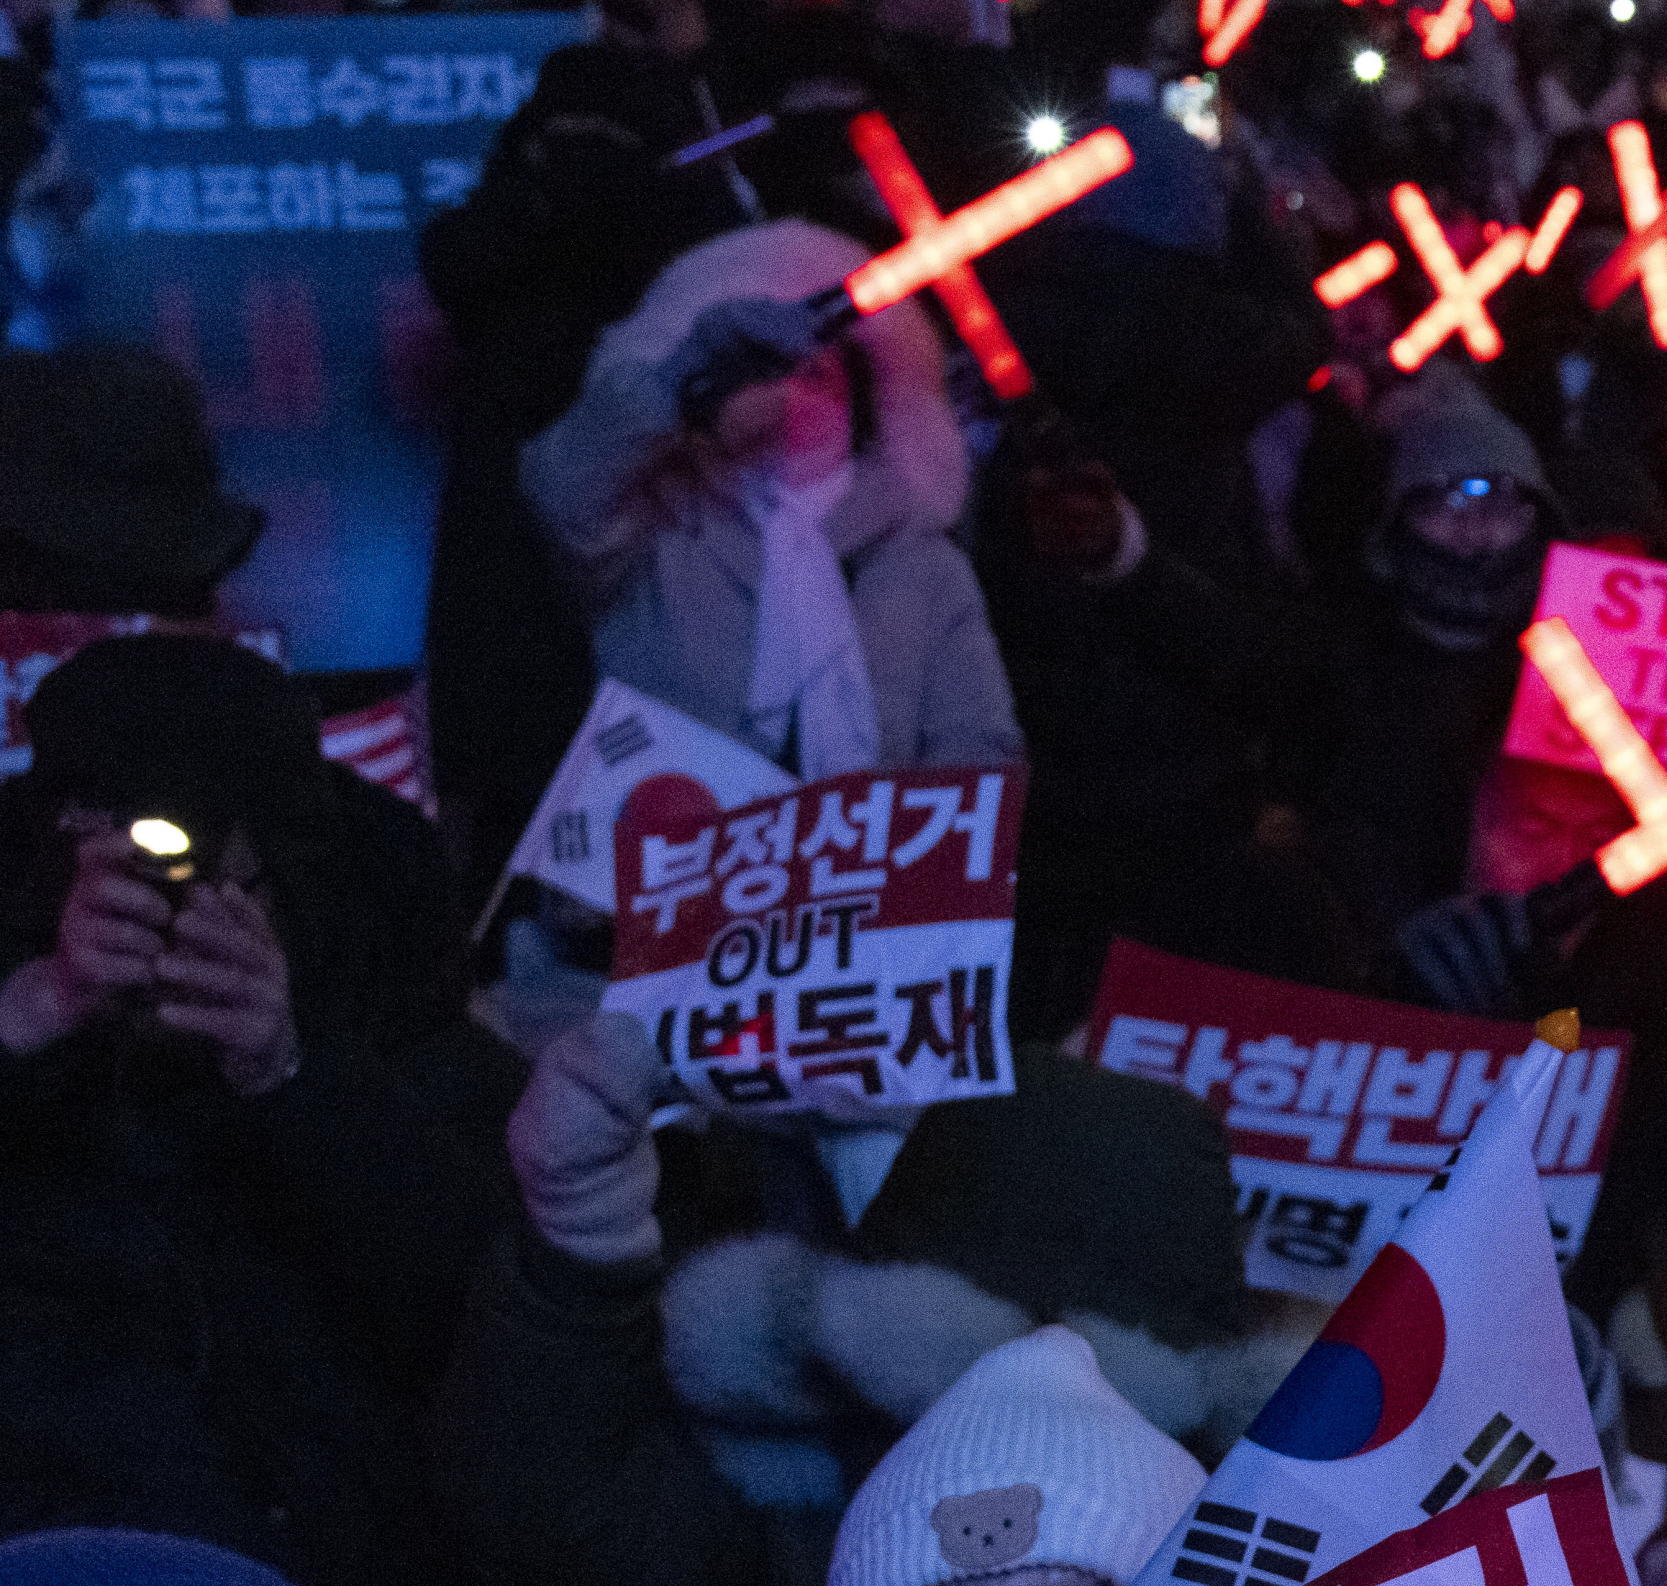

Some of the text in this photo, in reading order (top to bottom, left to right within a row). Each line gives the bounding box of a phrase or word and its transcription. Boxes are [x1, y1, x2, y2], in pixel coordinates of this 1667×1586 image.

[632, 773, 1004, 935] 부정선거
[708, 902, 872, 988] OUT
[656, 966, 998, 1102] 법독재
